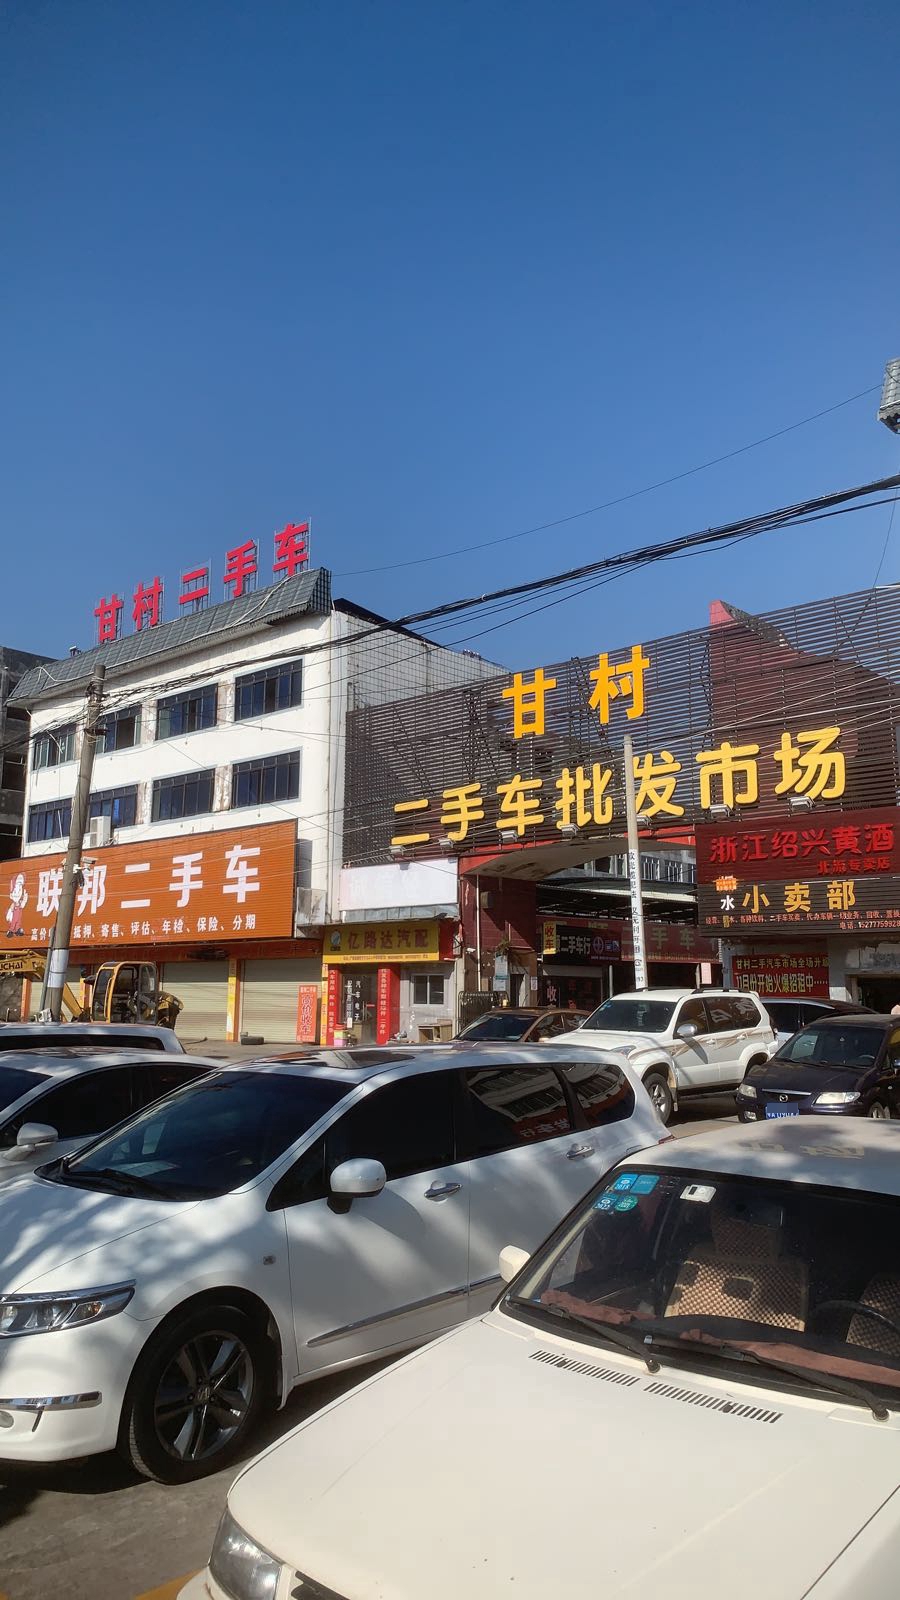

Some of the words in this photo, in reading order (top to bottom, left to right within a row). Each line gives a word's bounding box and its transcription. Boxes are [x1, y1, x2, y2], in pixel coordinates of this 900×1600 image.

[94, 522, 309, 643] 甘村二手车
[502, 645, 650, 738] 甘村
[391, 726, 848, 845] 二手车批发市场
[709, 823, 894, 863] 浙江绍兴黄酒
[36, 845, 261, 917] 联邦二手车
[720, 895, 735, 911] 水
[742, 880, 856, 914] 小卖部
[348, 928, 429, 950] 亿路达汽配
[544, 926, 554, 949] 收车
